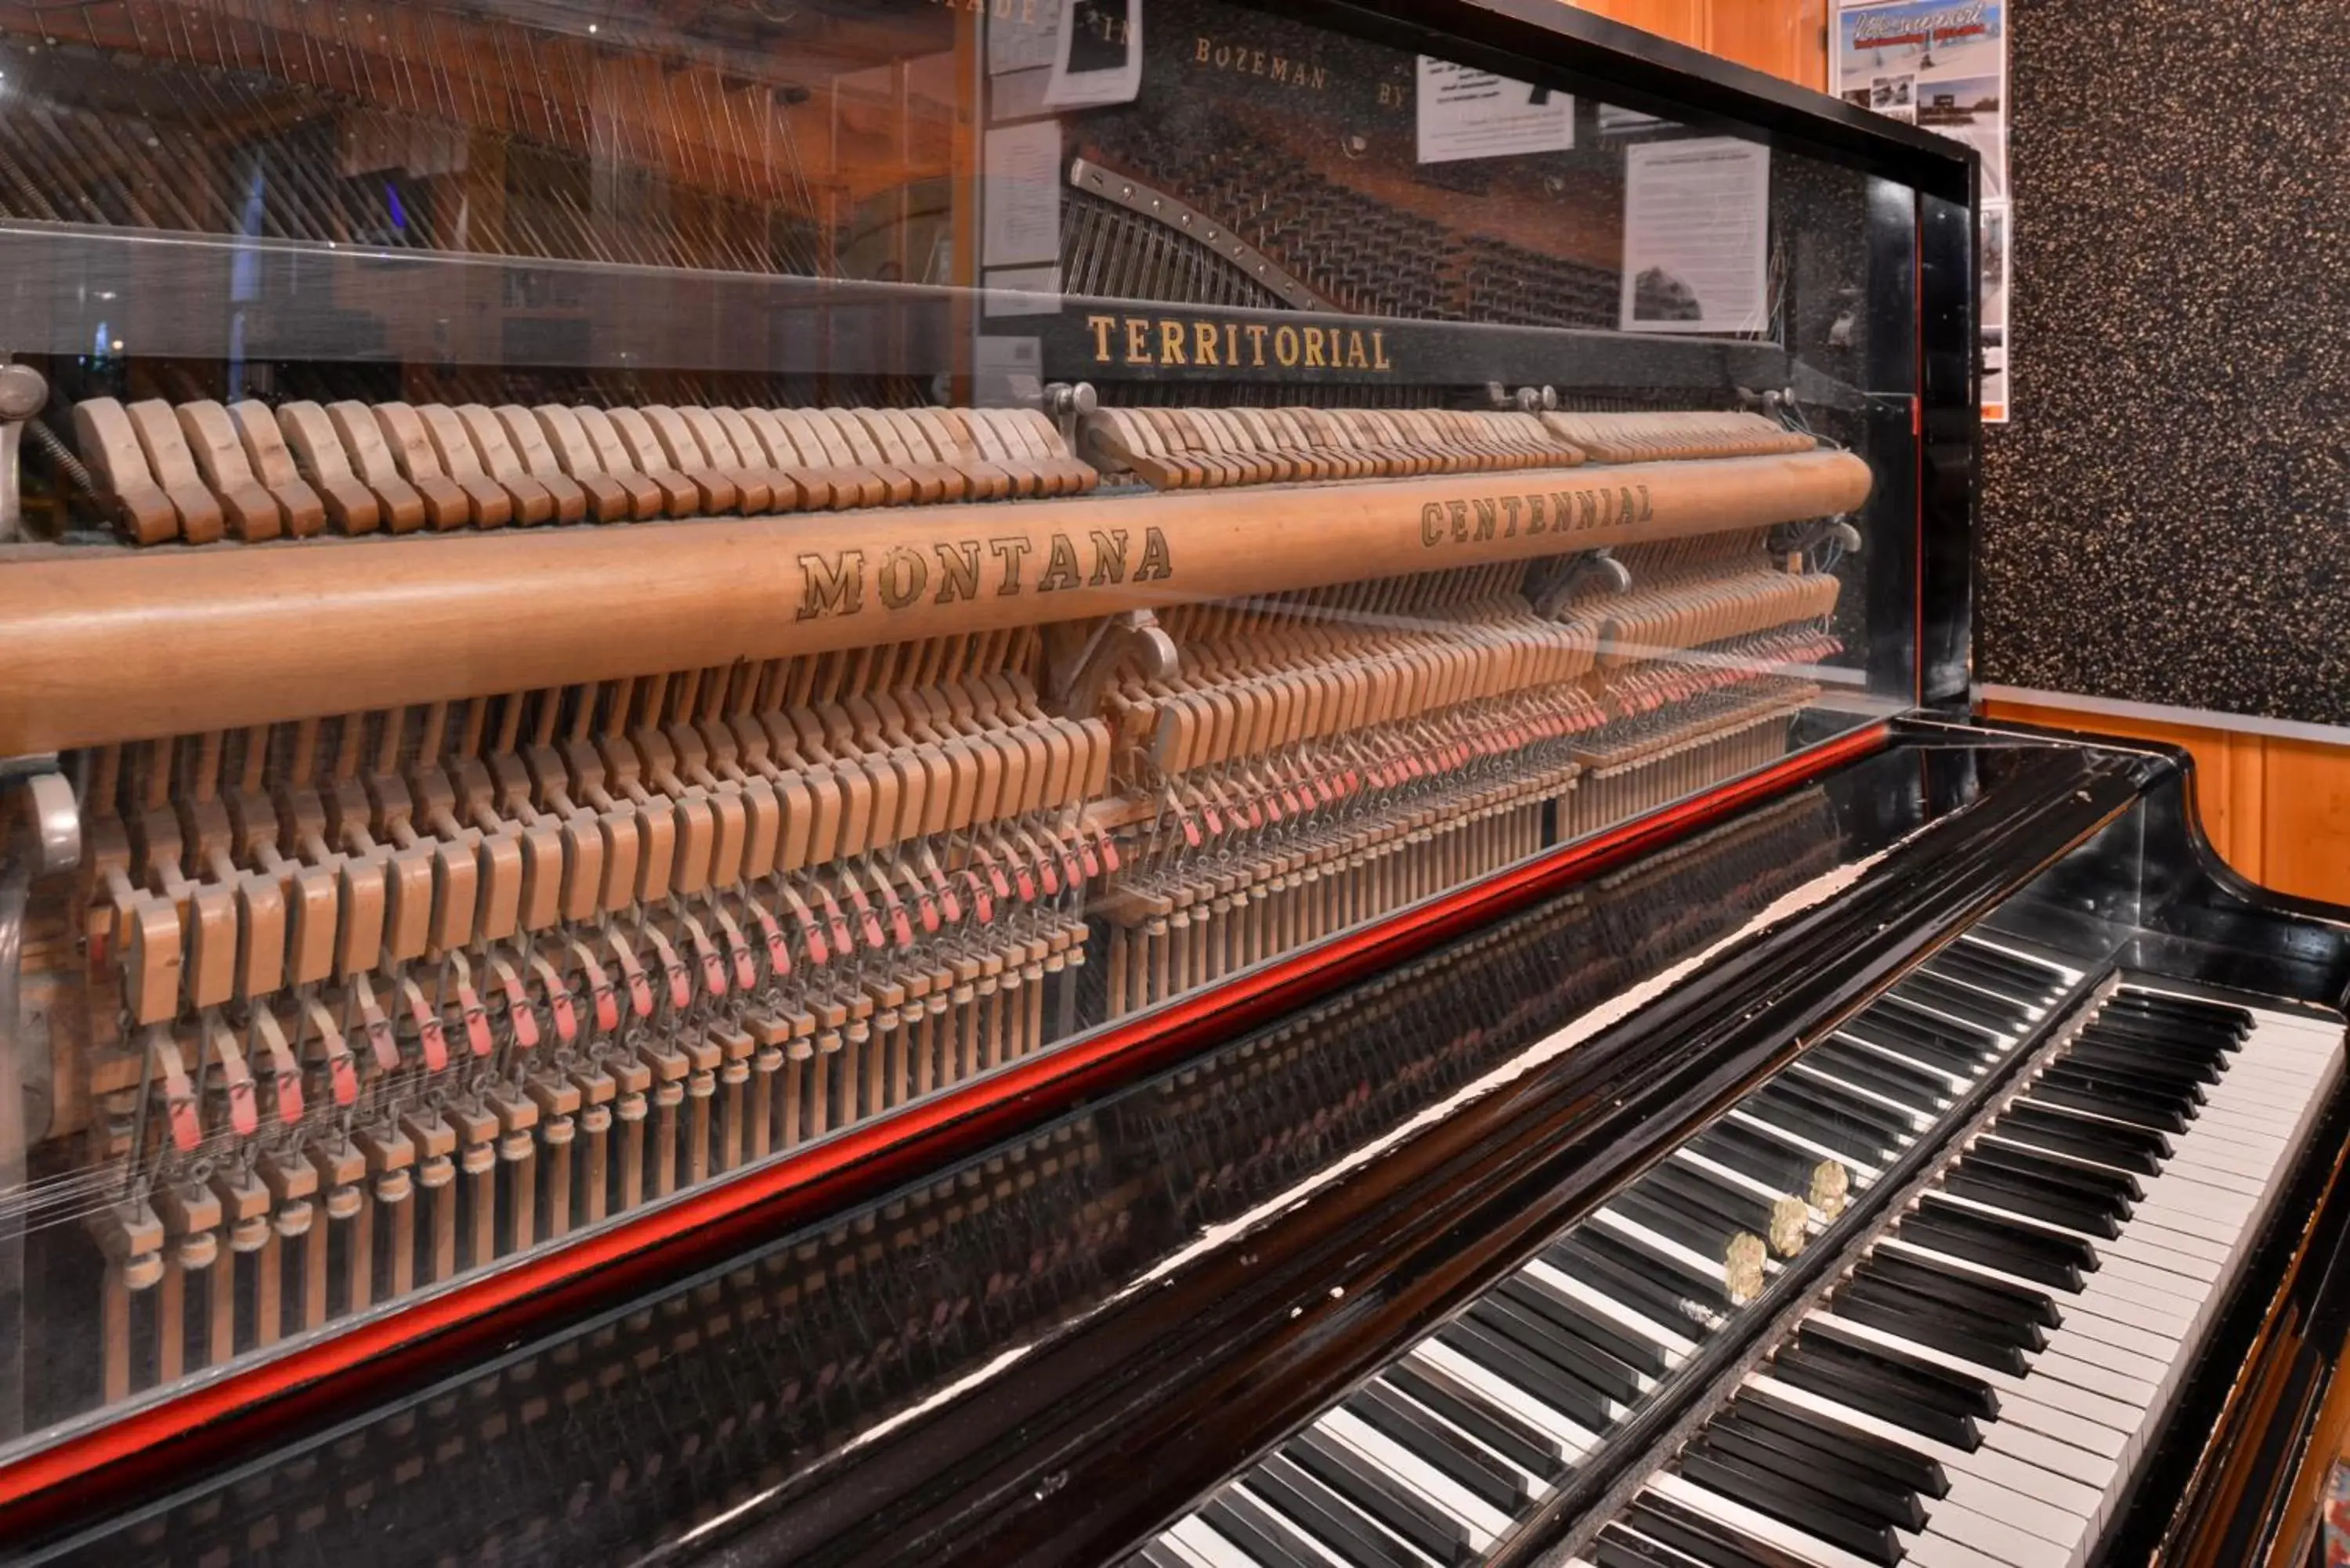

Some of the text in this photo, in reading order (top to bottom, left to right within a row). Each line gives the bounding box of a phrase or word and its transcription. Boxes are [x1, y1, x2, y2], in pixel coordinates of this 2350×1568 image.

[930, 0, 1036, 25] ADE
[1103, 16, 1138, 45] IN
[1195, 38, 1327, 89] BOZEMAN
[1377, 81, 1405, 107] BY
[1087, 315, 1391, 370] TERRITORIAL
[795, 484, 1654, 621] MONTANA CENTENNIAL
